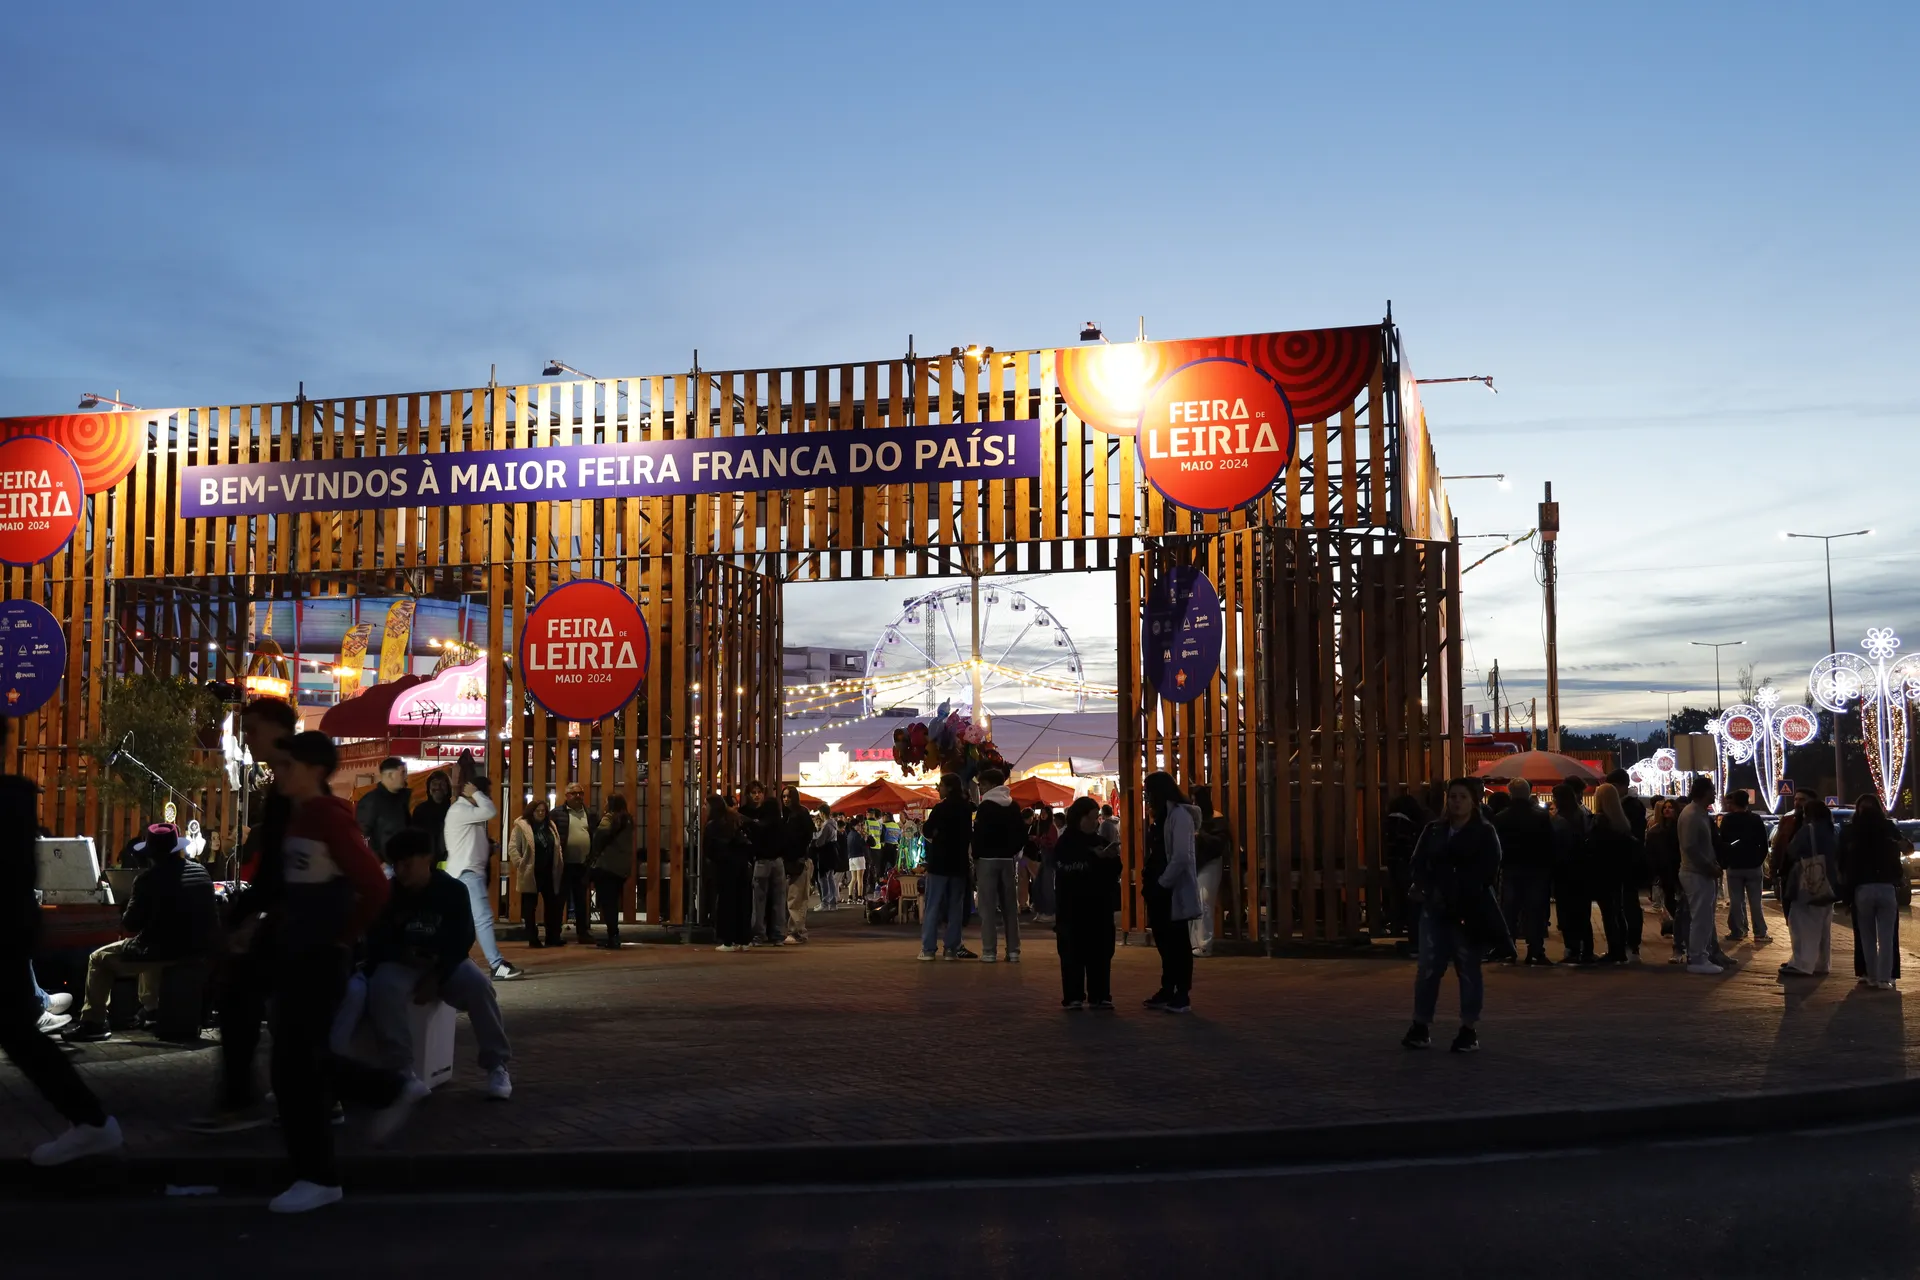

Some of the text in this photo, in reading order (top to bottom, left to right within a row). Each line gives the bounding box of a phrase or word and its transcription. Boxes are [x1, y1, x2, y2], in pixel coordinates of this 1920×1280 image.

[1169, 398, 1266, 424] FEIRA DE
[1149, 422, 1280, 459] LEIRIA
[199, 428, 1016, 506] BEM-VINDOS À MAIOR FEIRA FRANCA DO PAÍS!
[1180, 458, 1249, 472] MAIO 2024
[0, 470, 52, 490] EIRA
[0, 521, 50, 531] MAIO 2024
[547, 617, 614, 639] FEIRA
[530, 641, 638, 671] LEIRIA
[555, 673, 612, 684] MAIO 2024
[439, 745, 485, 757] PIPOC
